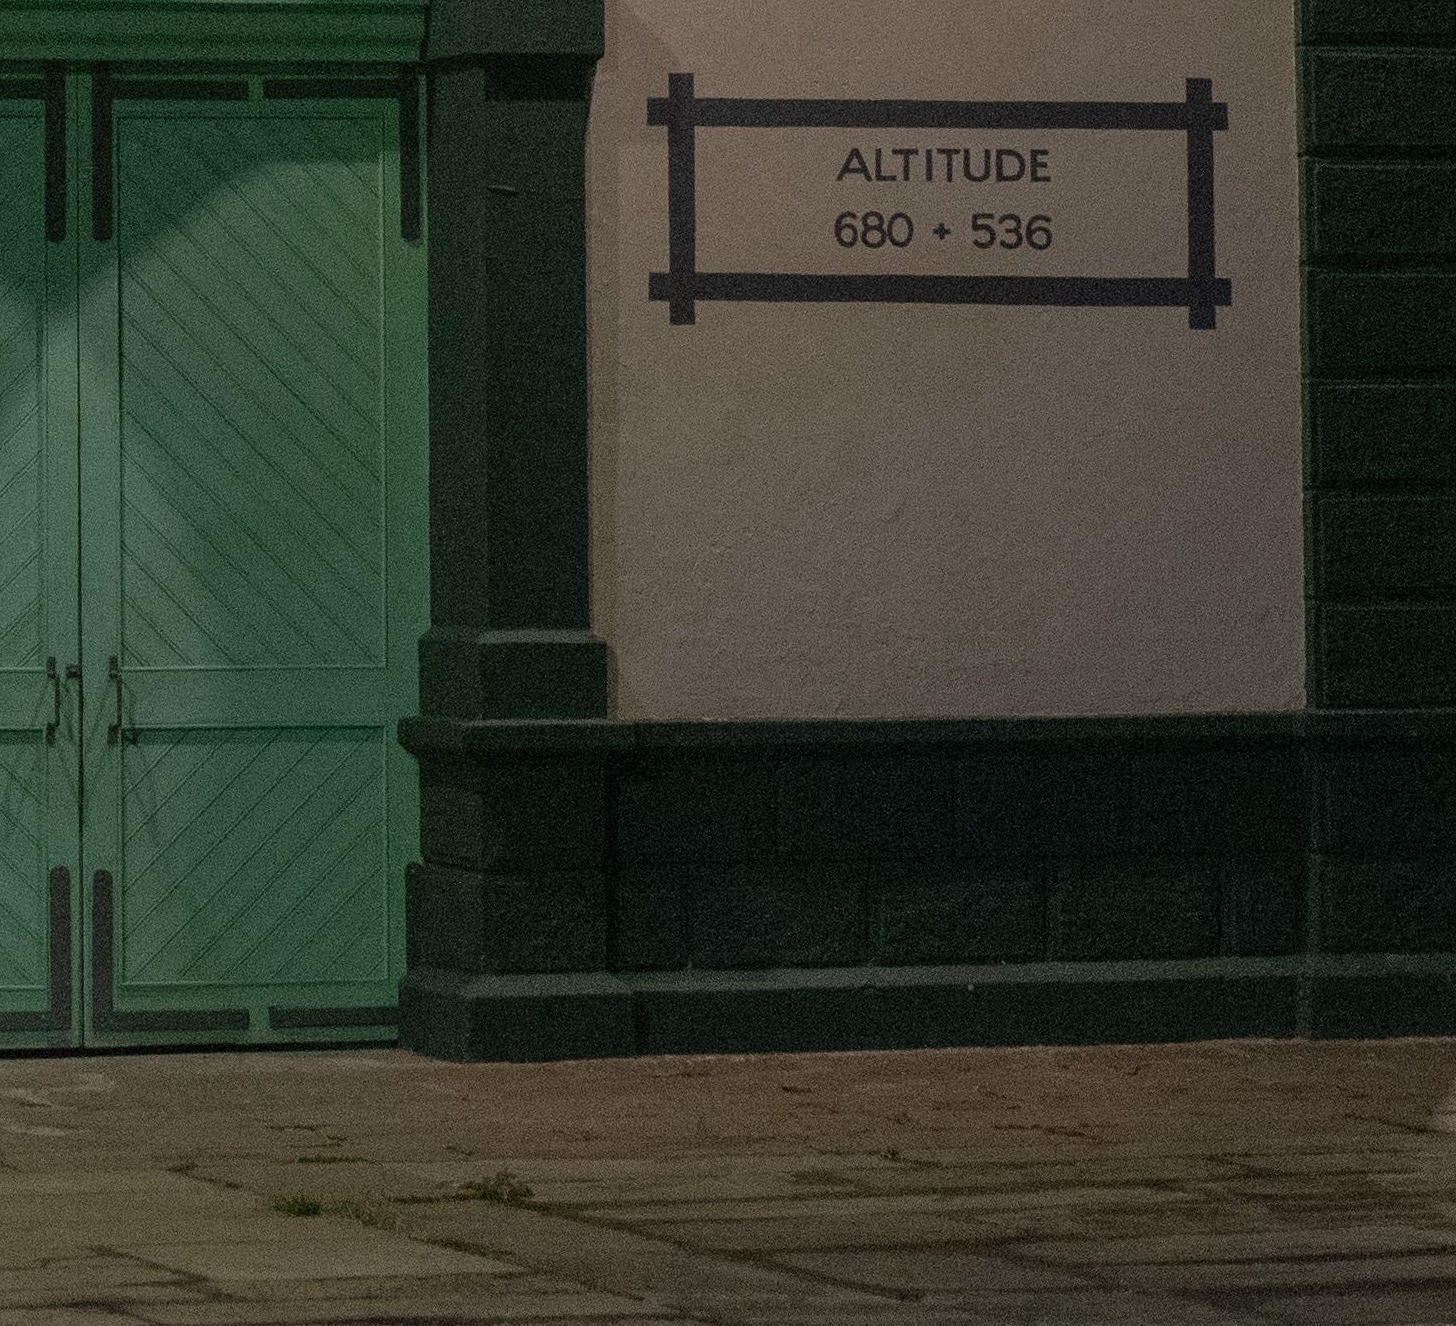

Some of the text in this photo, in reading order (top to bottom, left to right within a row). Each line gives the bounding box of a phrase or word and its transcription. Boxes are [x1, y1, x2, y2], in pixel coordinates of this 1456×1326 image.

[837, 147, 1052, 184] ALTITUDE
[834, 210, 915, 250] 680
[972, 212, 1053, 252] 536
